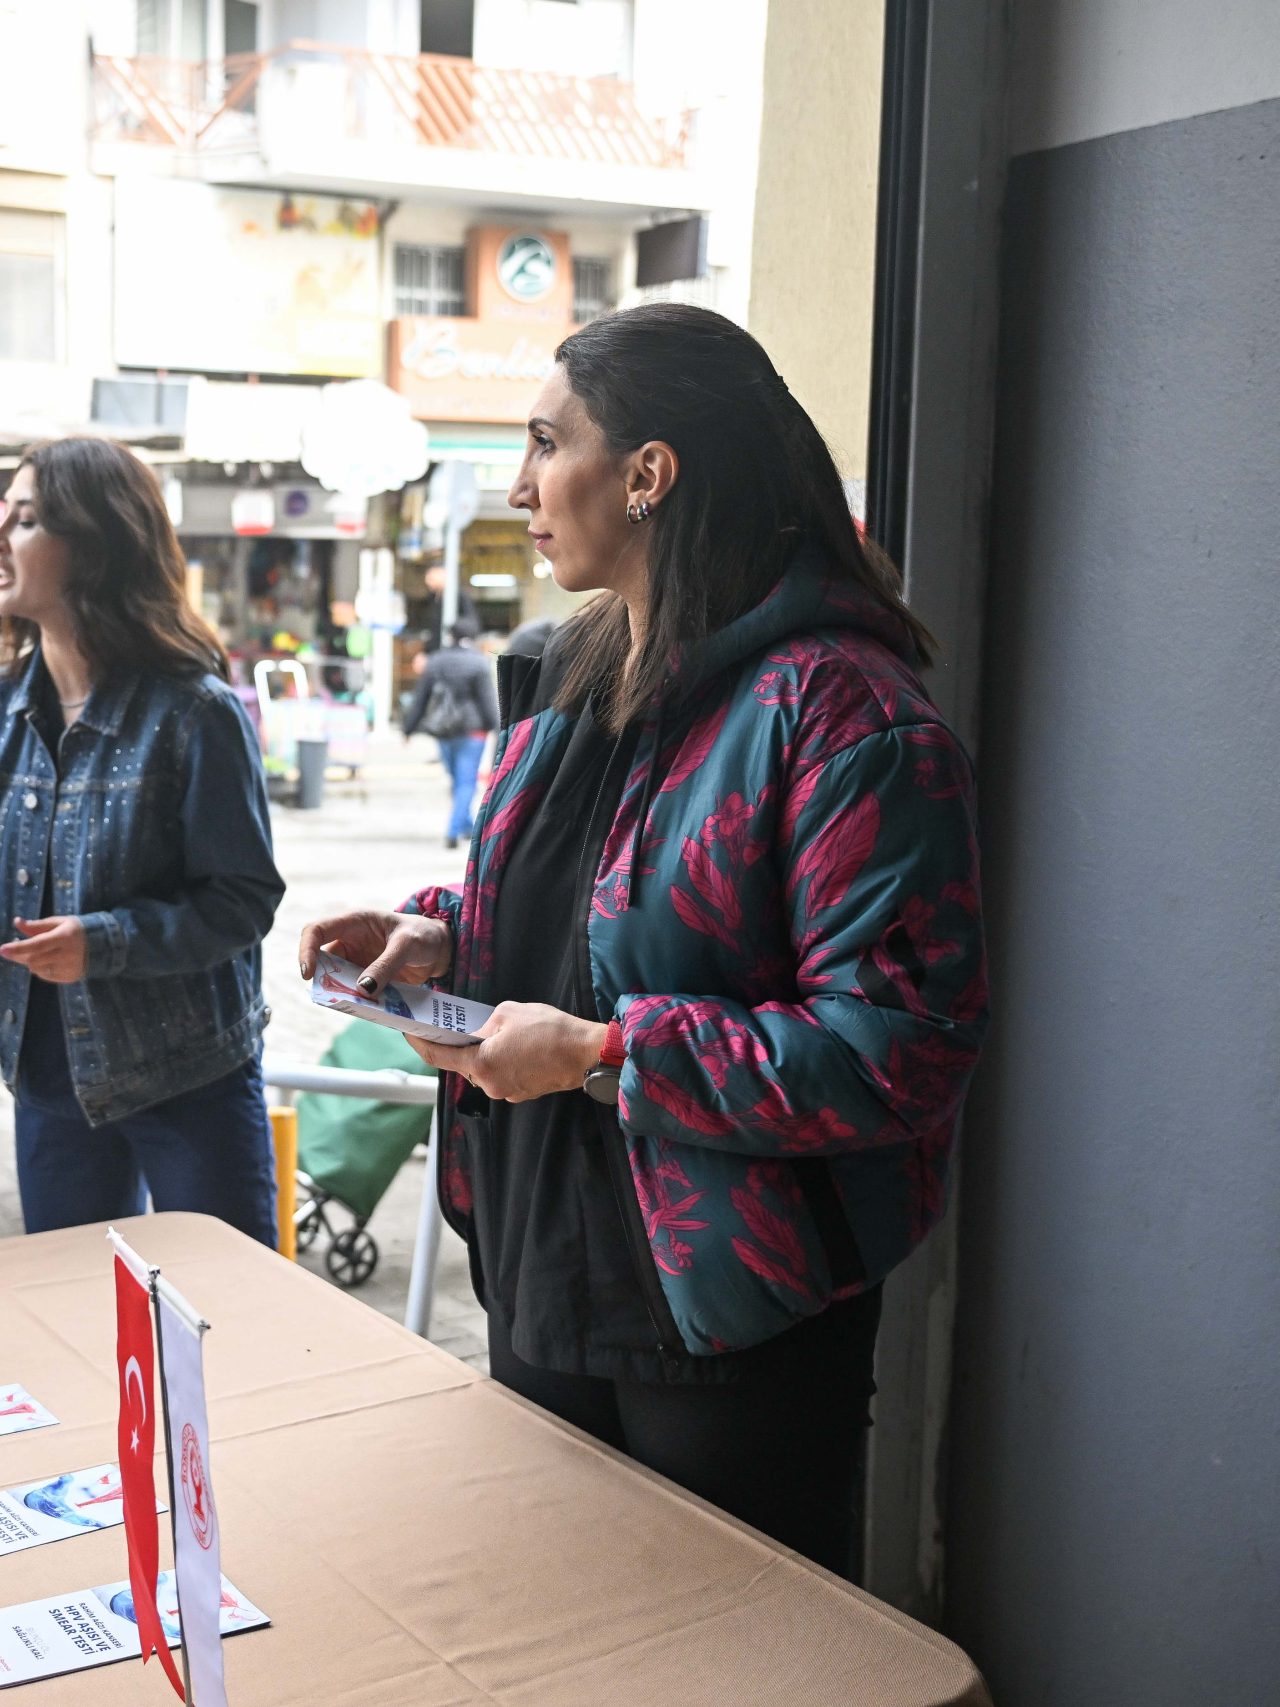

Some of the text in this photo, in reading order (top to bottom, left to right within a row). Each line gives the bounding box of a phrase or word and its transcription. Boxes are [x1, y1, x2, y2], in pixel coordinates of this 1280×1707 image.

[442, 1000, 453, 1011] VE
[453, 1004, 466, 1026] TESTİ
[14, 1530, 29, 1541] VE
[48, 1608, 77, 1636] SMEAR
[71, 1634, 99, 1655] TESTİ
[63, 1605, 111, 1652] HPV AŞISI VE
